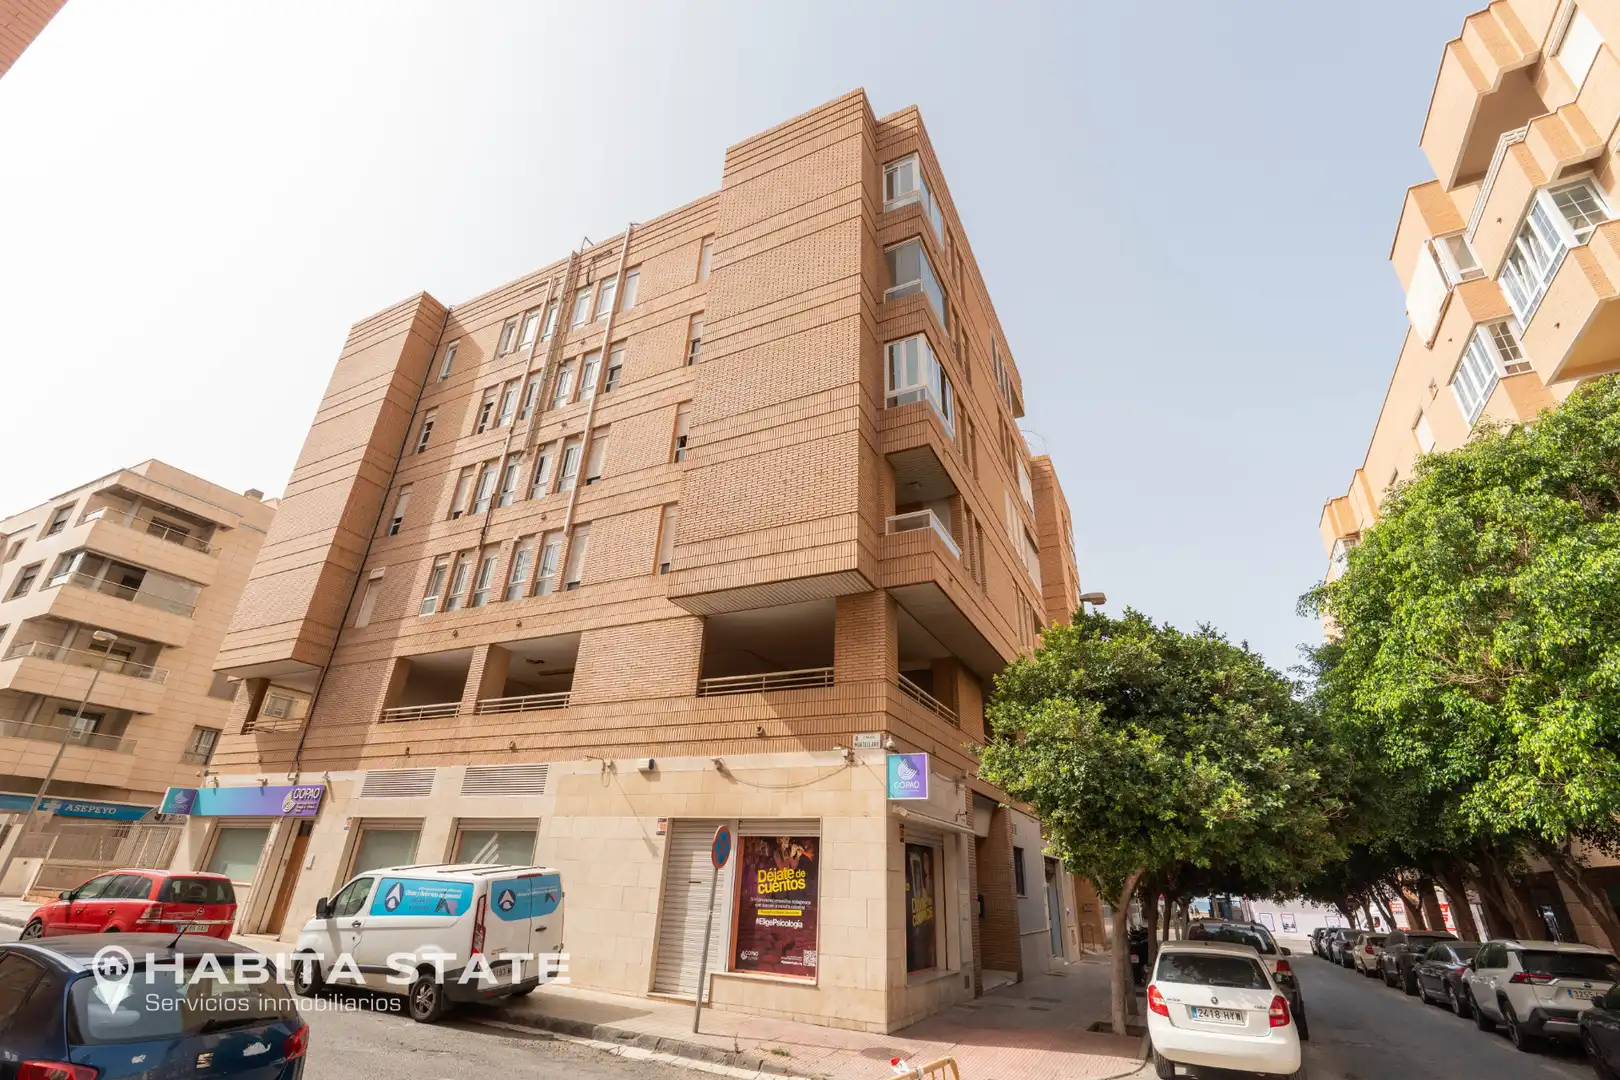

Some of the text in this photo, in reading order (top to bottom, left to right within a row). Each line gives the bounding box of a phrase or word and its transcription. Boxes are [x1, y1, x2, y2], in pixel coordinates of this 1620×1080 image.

[893, 780, 920, 789] COPAO
[293, 787, 320, 799] COPAO
[65, 803, 117, 815] ASEPEYO
[757, 867, 806, 883] Déjate de
[757, 878, 806, 894] cuentos
[755, 917, 803, 930] #EligePsicología
[1197, 1008, 1221, 1019] 2418
